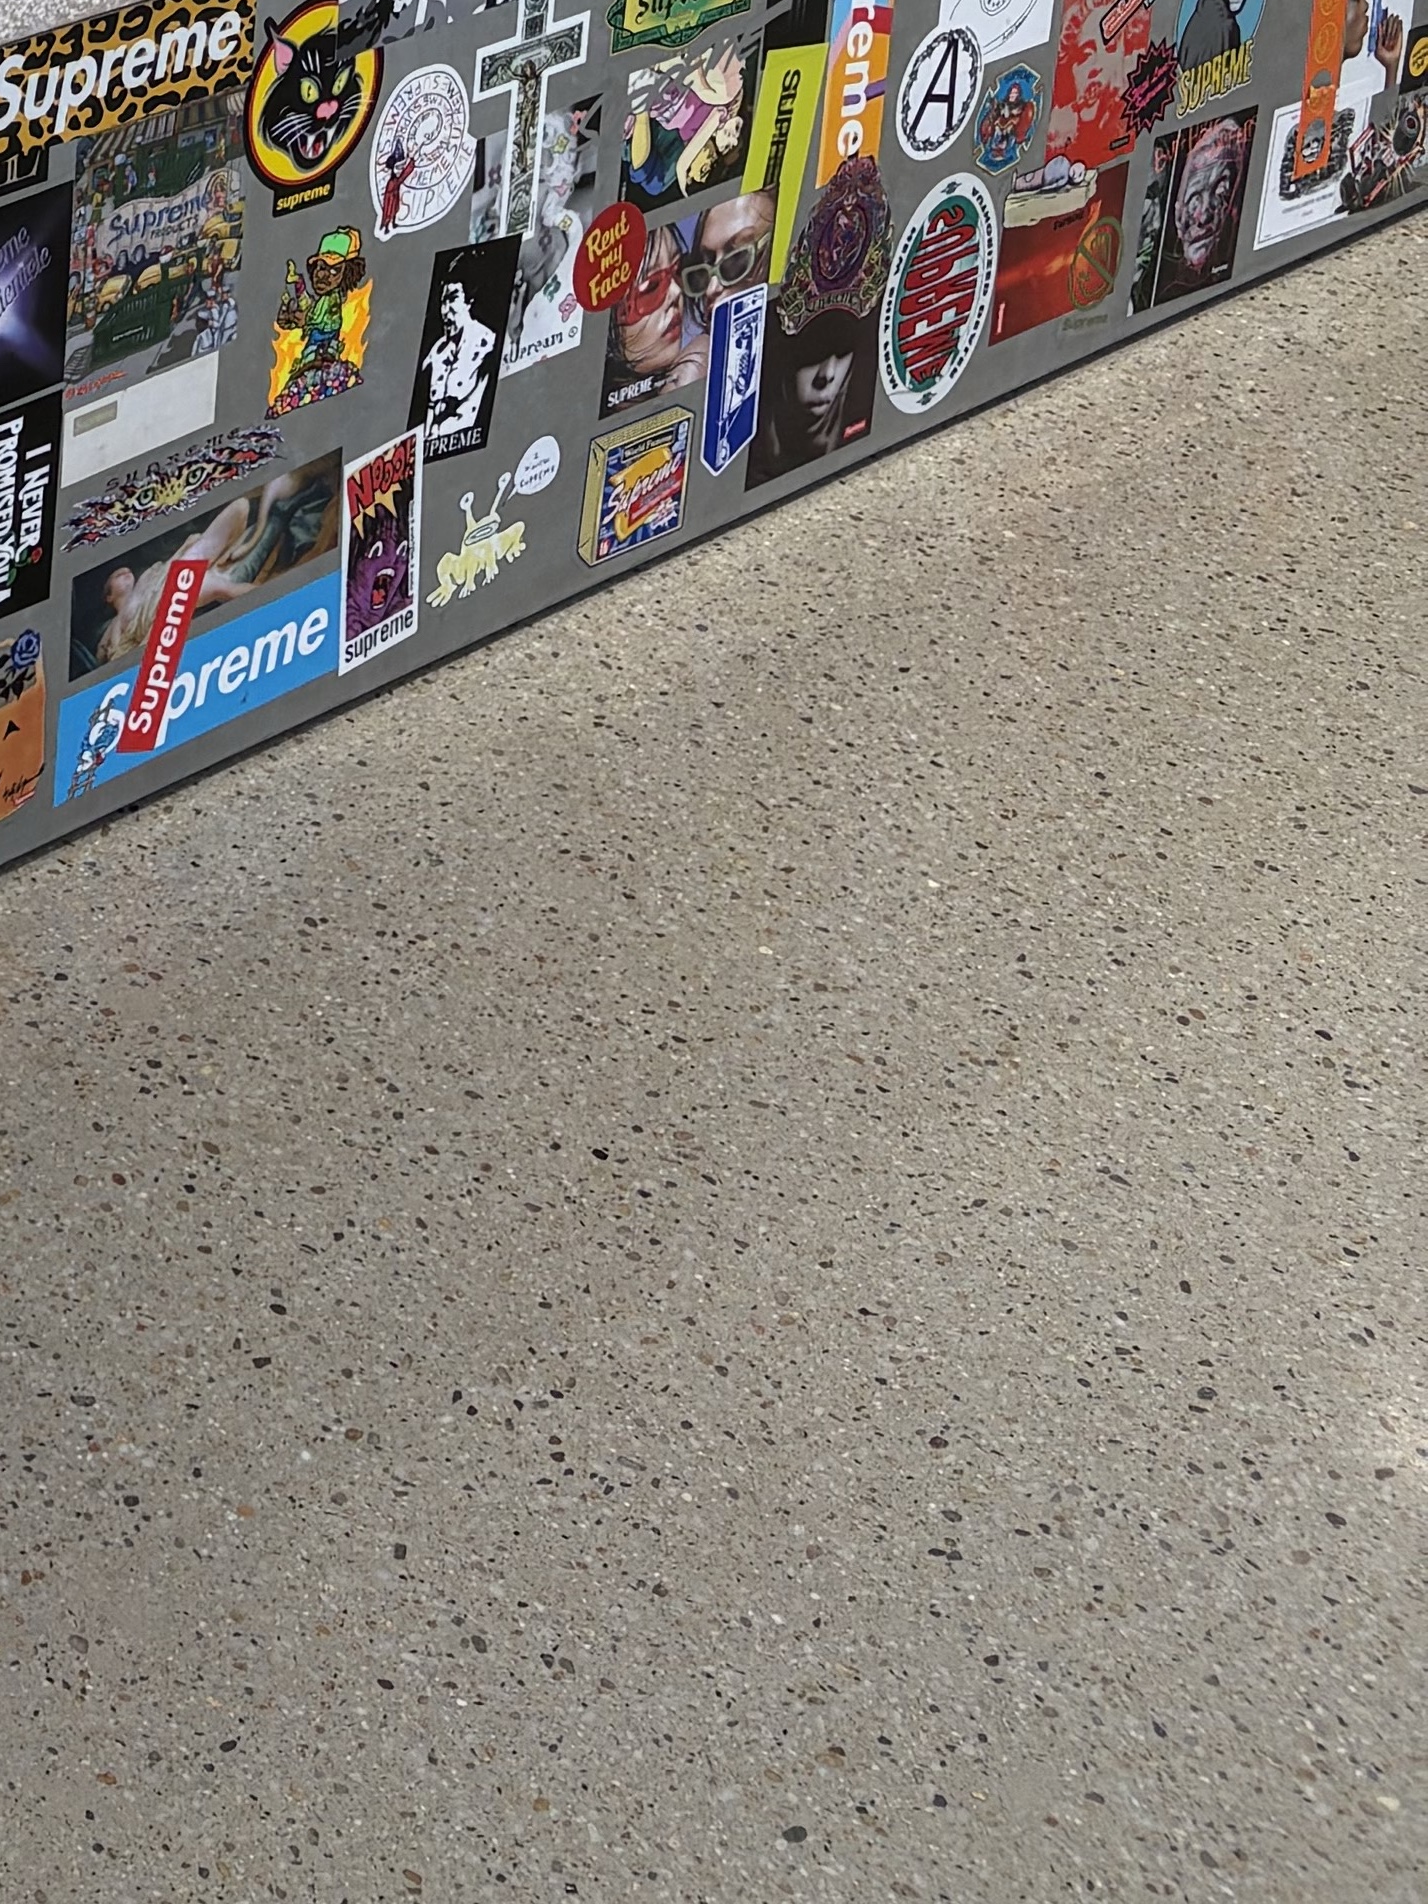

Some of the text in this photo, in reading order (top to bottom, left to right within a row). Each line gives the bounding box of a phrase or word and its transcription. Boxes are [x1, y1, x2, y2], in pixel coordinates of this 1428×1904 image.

[1176, 40, 1254, 119] SUPREME
[275, 182, 332, 213] supreme
[586, 210, 630, 263] Rent
[600, 244, 623, 273] my
[588, 261, 632, 307] Face
[607, 374, 654, 407] SUPREME
[13, 464, 50, 561] NEVER
[128, 567, 196, 734] Supreme
[344, 609, 414, 664] supreme
[84, 608, 329, 755] Spreme
